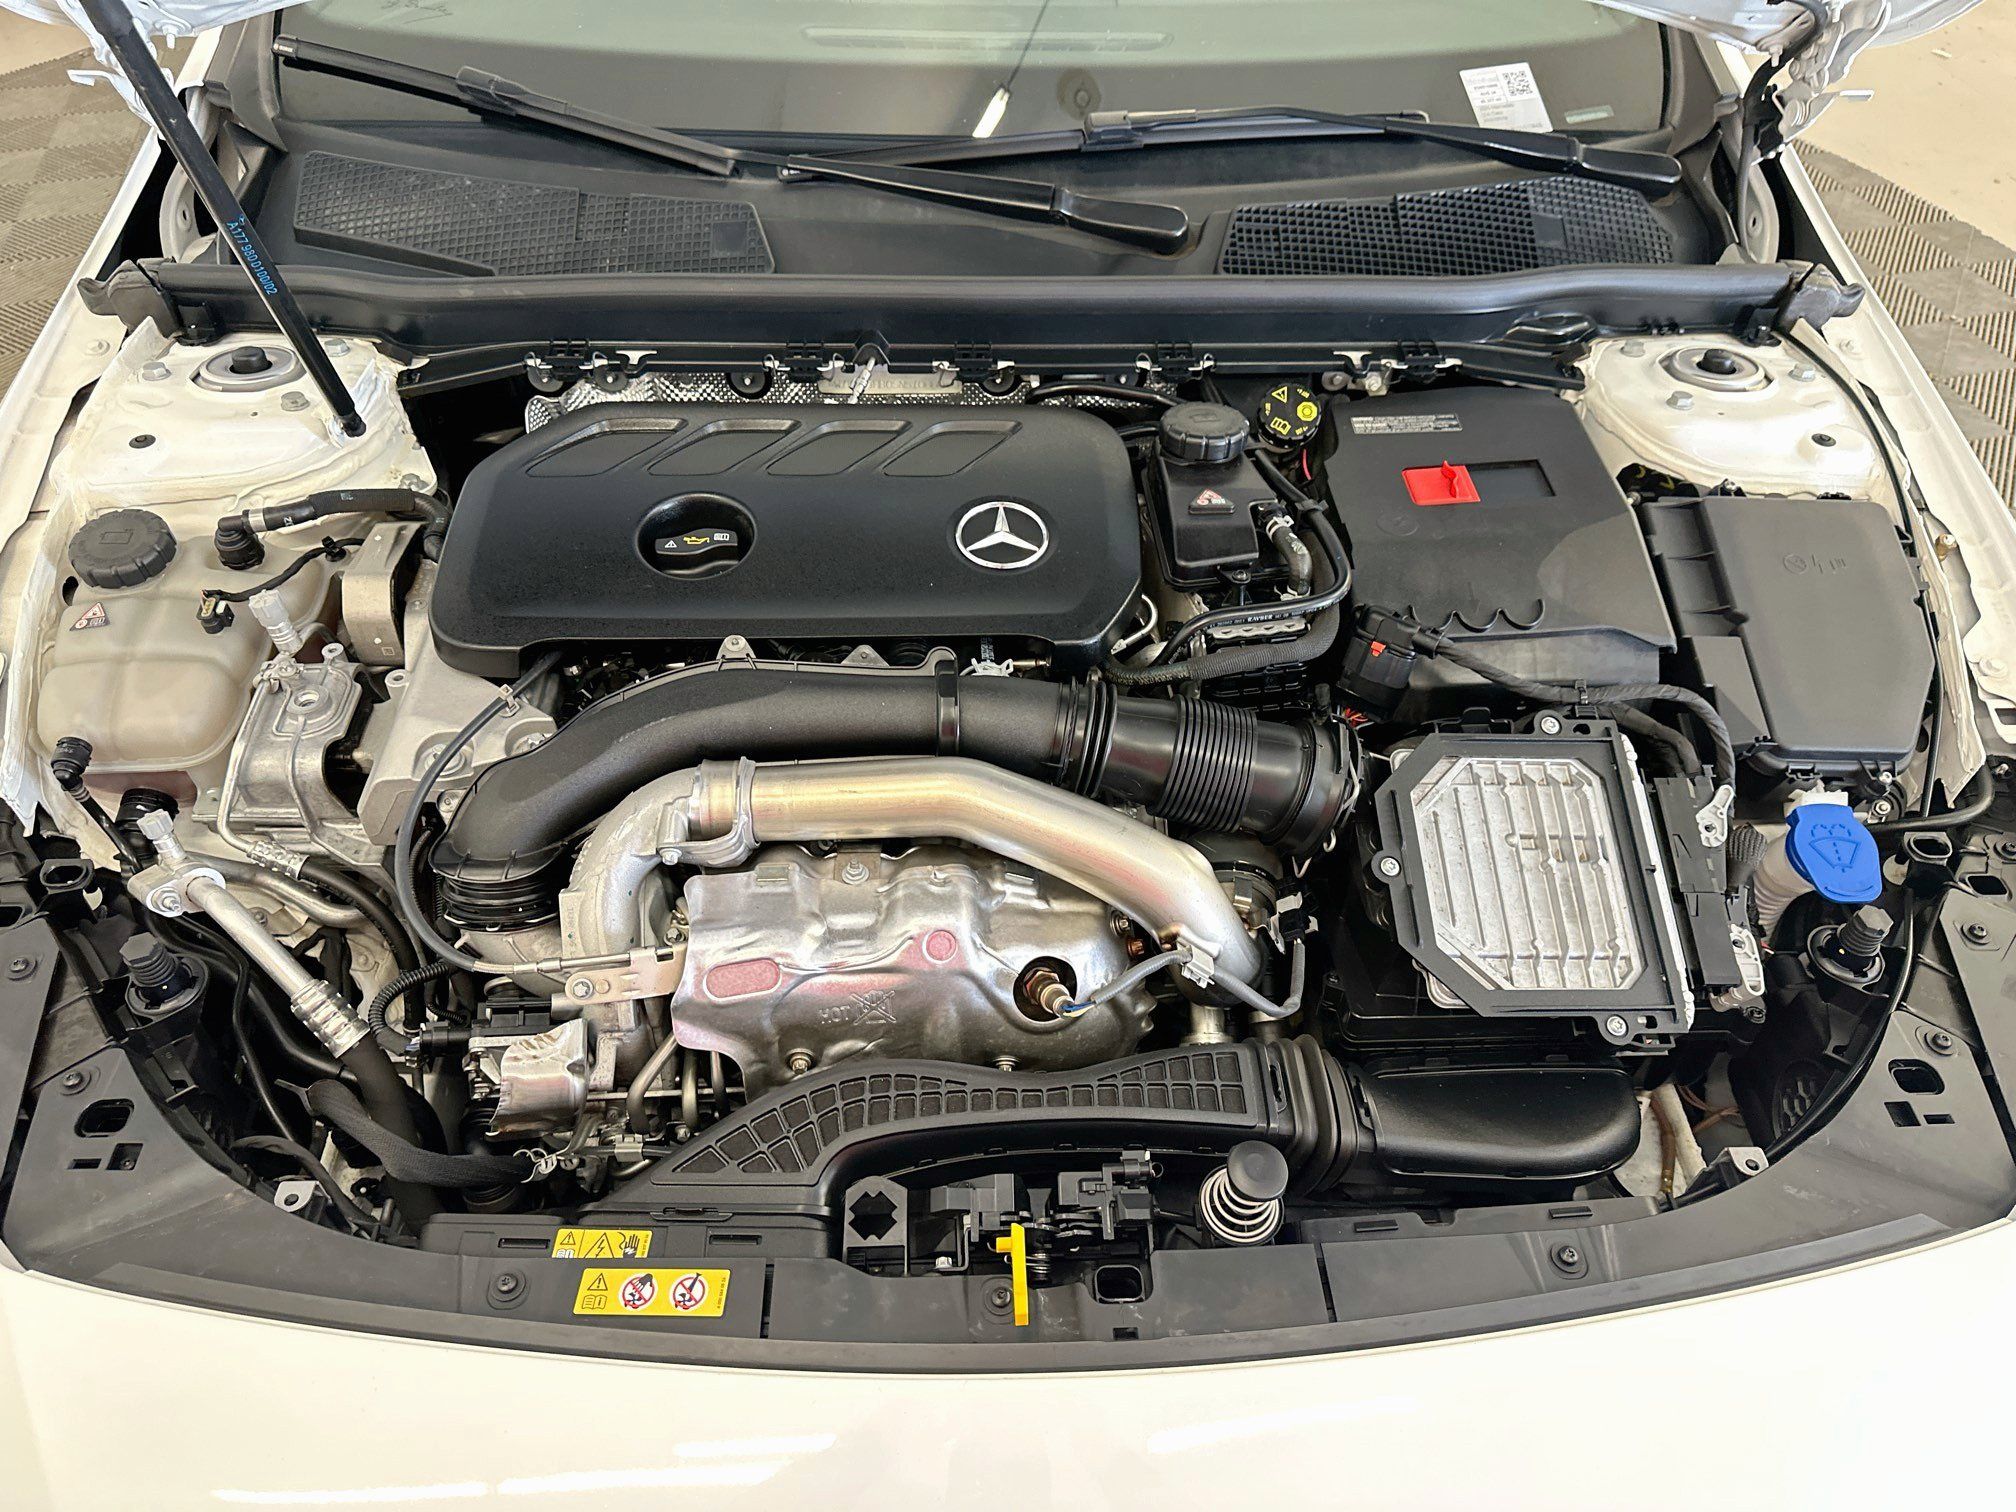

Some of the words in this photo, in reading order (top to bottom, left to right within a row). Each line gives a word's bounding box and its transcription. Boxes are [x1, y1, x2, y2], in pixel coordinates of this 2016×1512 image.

[226, 221, 249, 243] A177
[241, 244, 258, 262] 980
[819, 1005, 850, 1024] HOT
